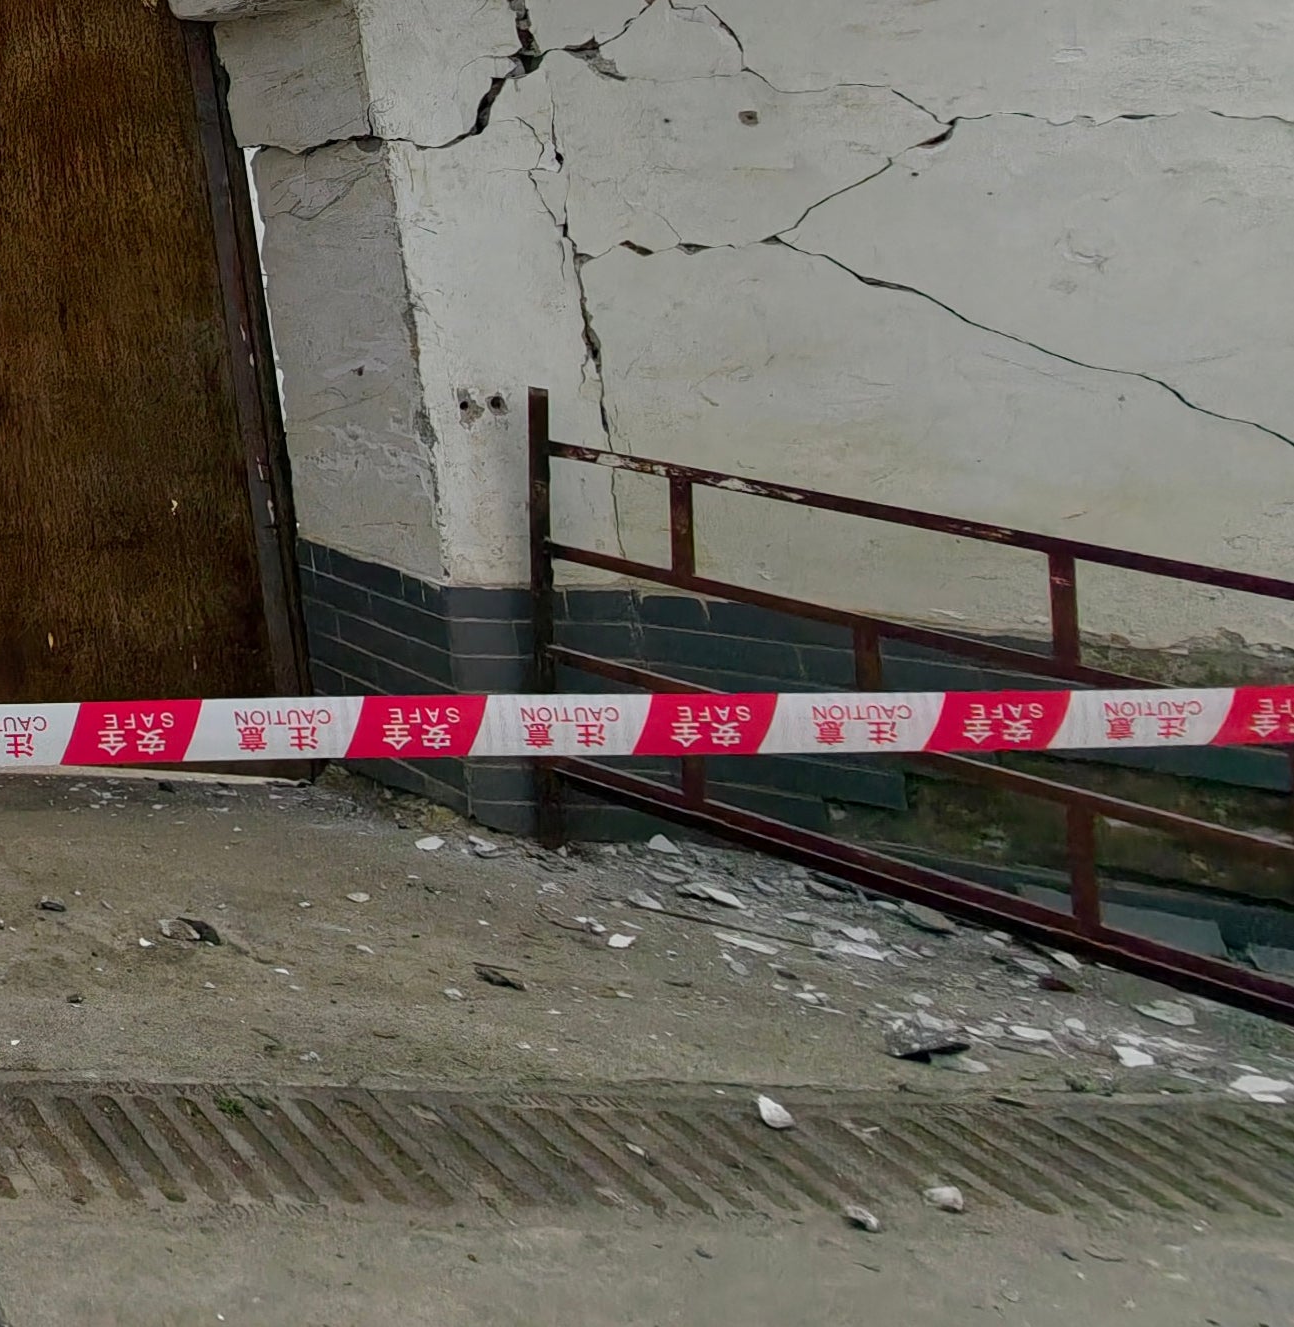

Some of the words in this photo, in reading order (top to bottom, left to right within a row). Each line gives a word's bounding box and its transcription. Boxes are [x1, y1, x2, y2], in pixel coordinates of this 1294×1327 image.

[233, 708, 331, 727] CAUTION
[389, 706, 460, 723] SAFE
[521, 706, 618, 723] CAUTION
[676, 705, 750, 722] SAFE
[812, 705, 912, 721] CAUTION
[970, 702, 1043, 720] SAFE
[1104, 700, 1202, 718] CAUTION
[104, 712, 174, 730] SAFE
[963, 717, 1033, 742] 安全
[1106, 717, 1186, 740] 注意
[97, 728, 165, 756] 安全
[238, 725, 318, 751] 注意
[383, 723, 452, 751] 安全
[524, 722, 606, 747] 注意
[670, 719, 741, 748] 安全
[815, 719, 898, 746] 注意
